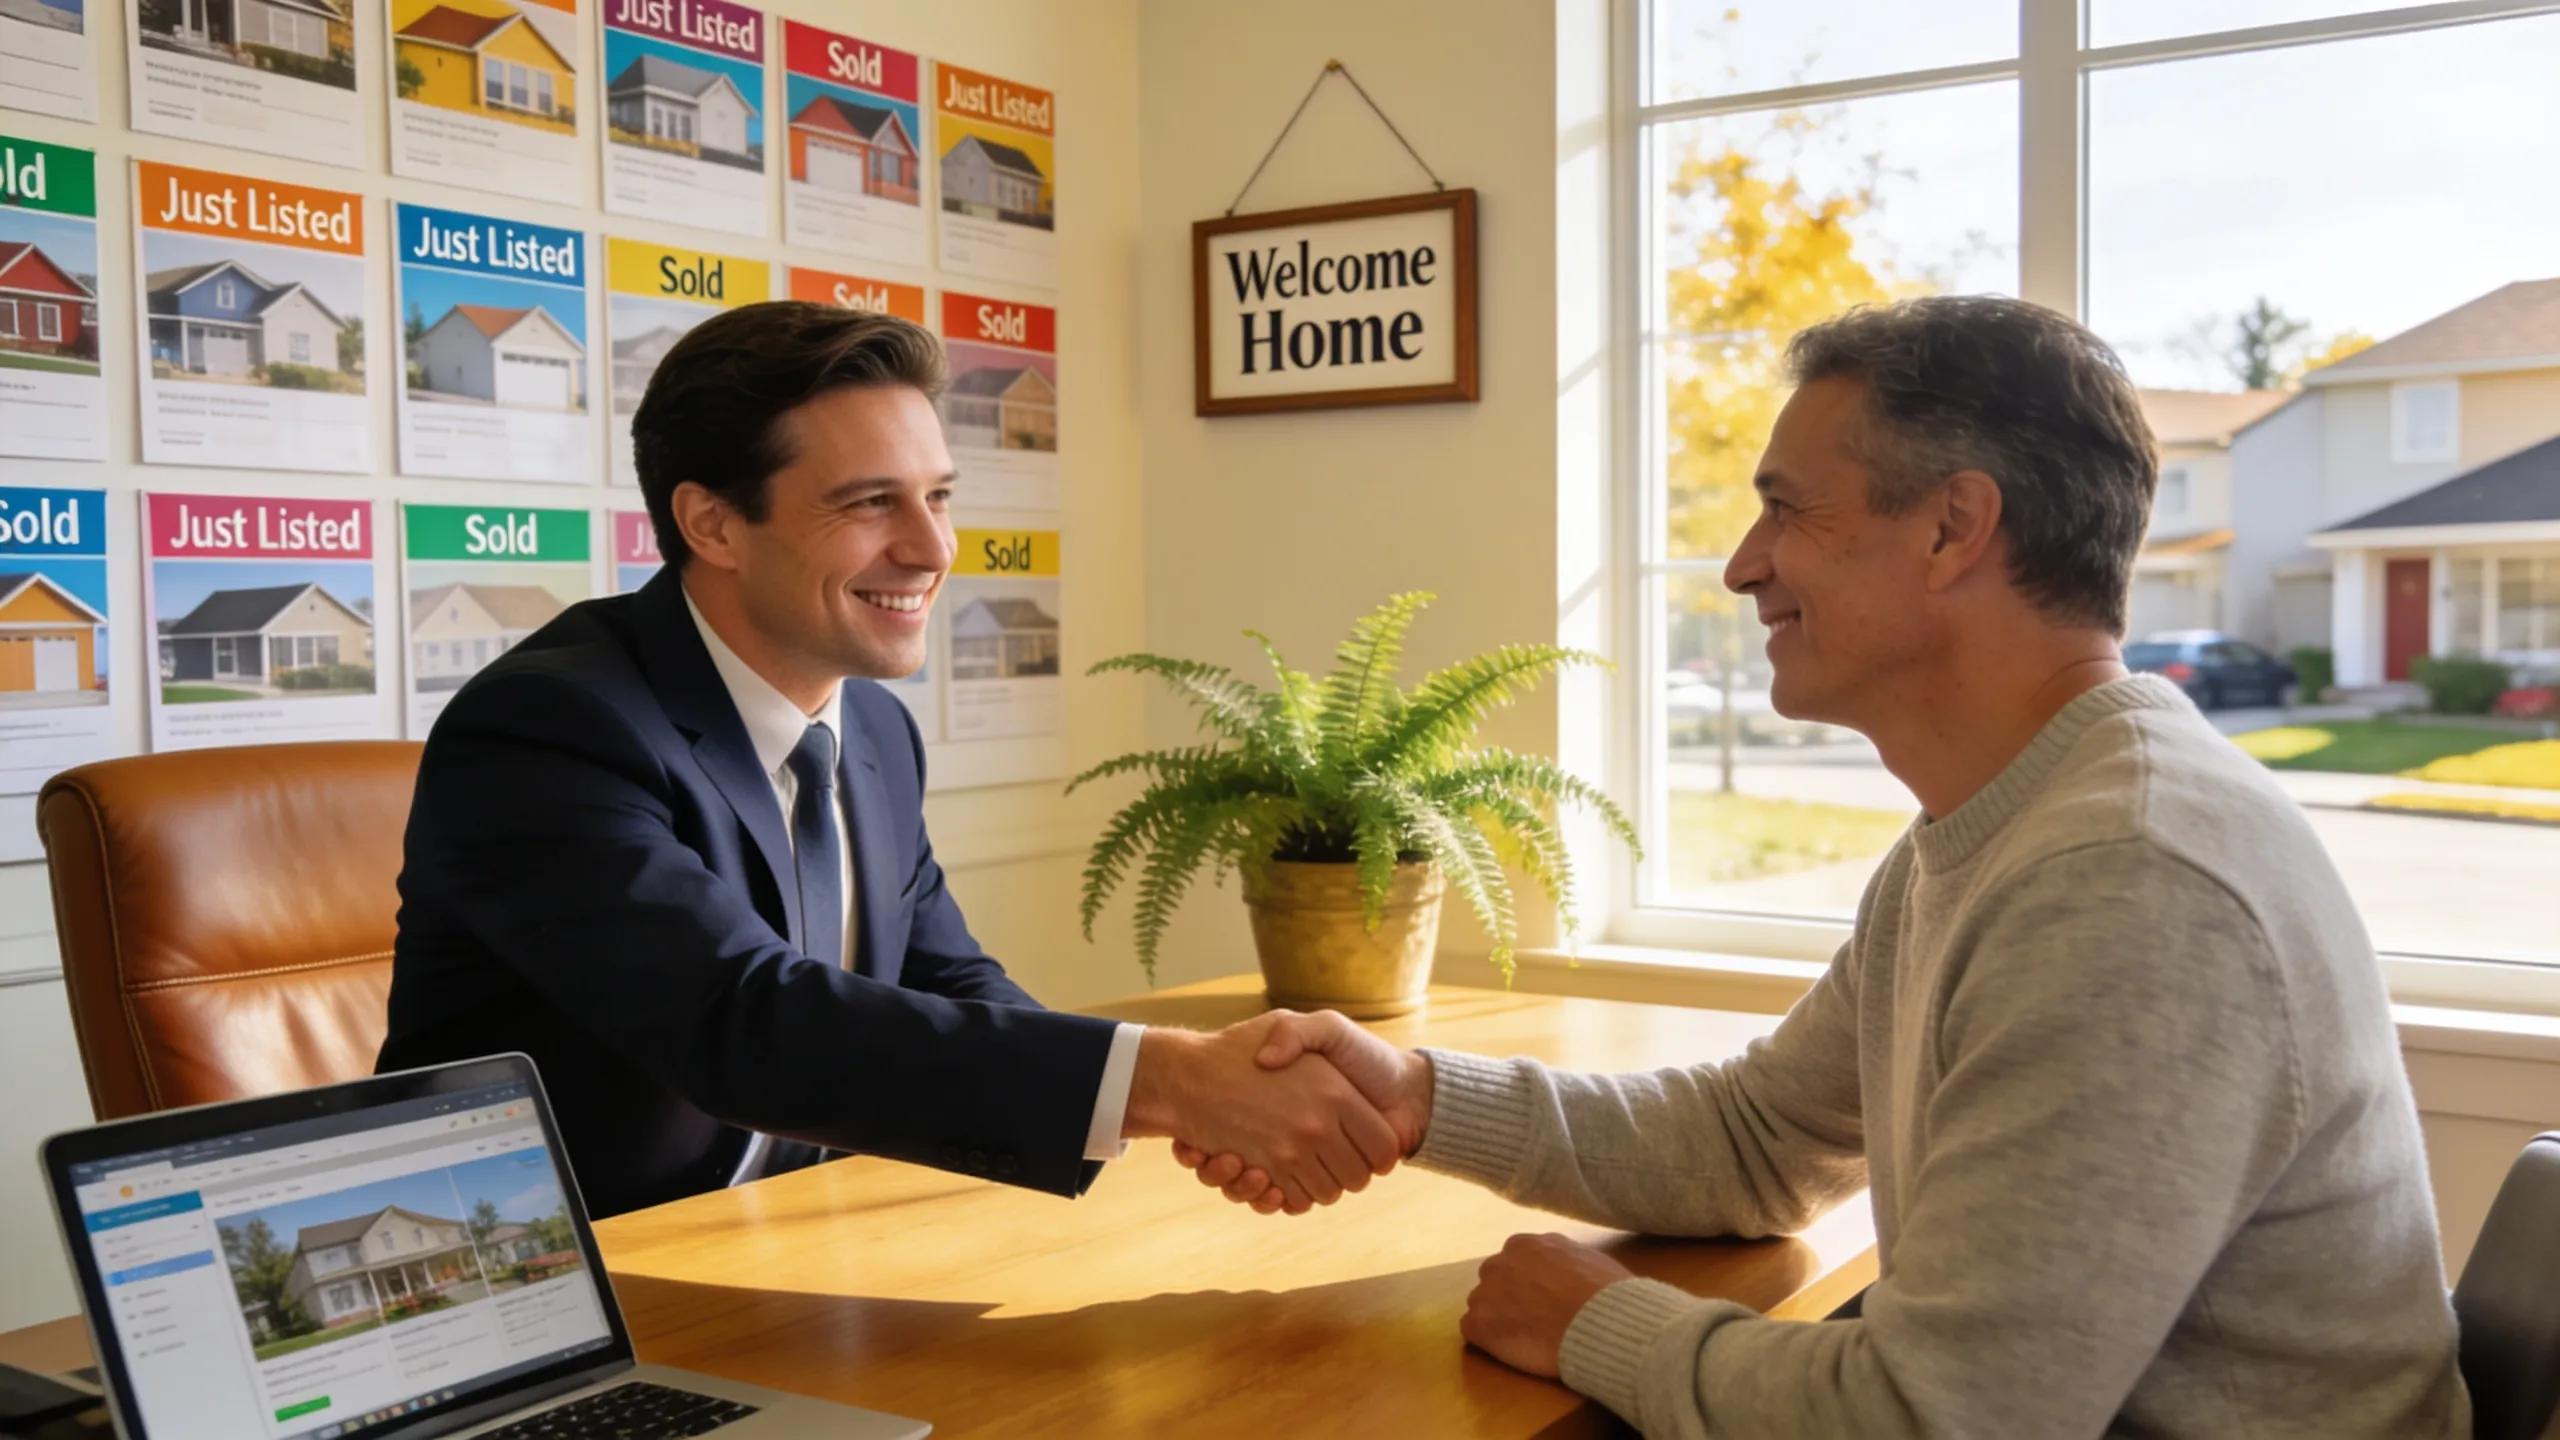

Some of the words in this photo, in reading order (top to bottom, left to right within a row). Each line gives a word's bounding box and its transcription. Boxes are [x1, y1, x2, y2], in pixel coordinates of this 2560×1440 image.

[616, 0, 673, 33] Just
[680, 0, 756, 53] Listed
[828, 41, 882, 87] Sold
[944, 75, 984, 114] Just
[991, 87, 1049, 130] Listed
[0, 147, 46, 201] ld
[161, 176, 237, 229] Just
[247, 188, 351, 244] Listed
[414, 217, 481, 263] Just
[489, 225, 575, 276] Listed
[1224, 239, 1436, 304] Welcome
[659, 256, 724, 299] Sold
[978, 304, 1027, 343] Sold
[1239, 309, 1424, 375] Home
[170, 504, 248, 549] Just
[258, 506, 361, 551] Listed
[465, 513, 538, 555] Sold
[984, 537, 1032, 571] Sold
